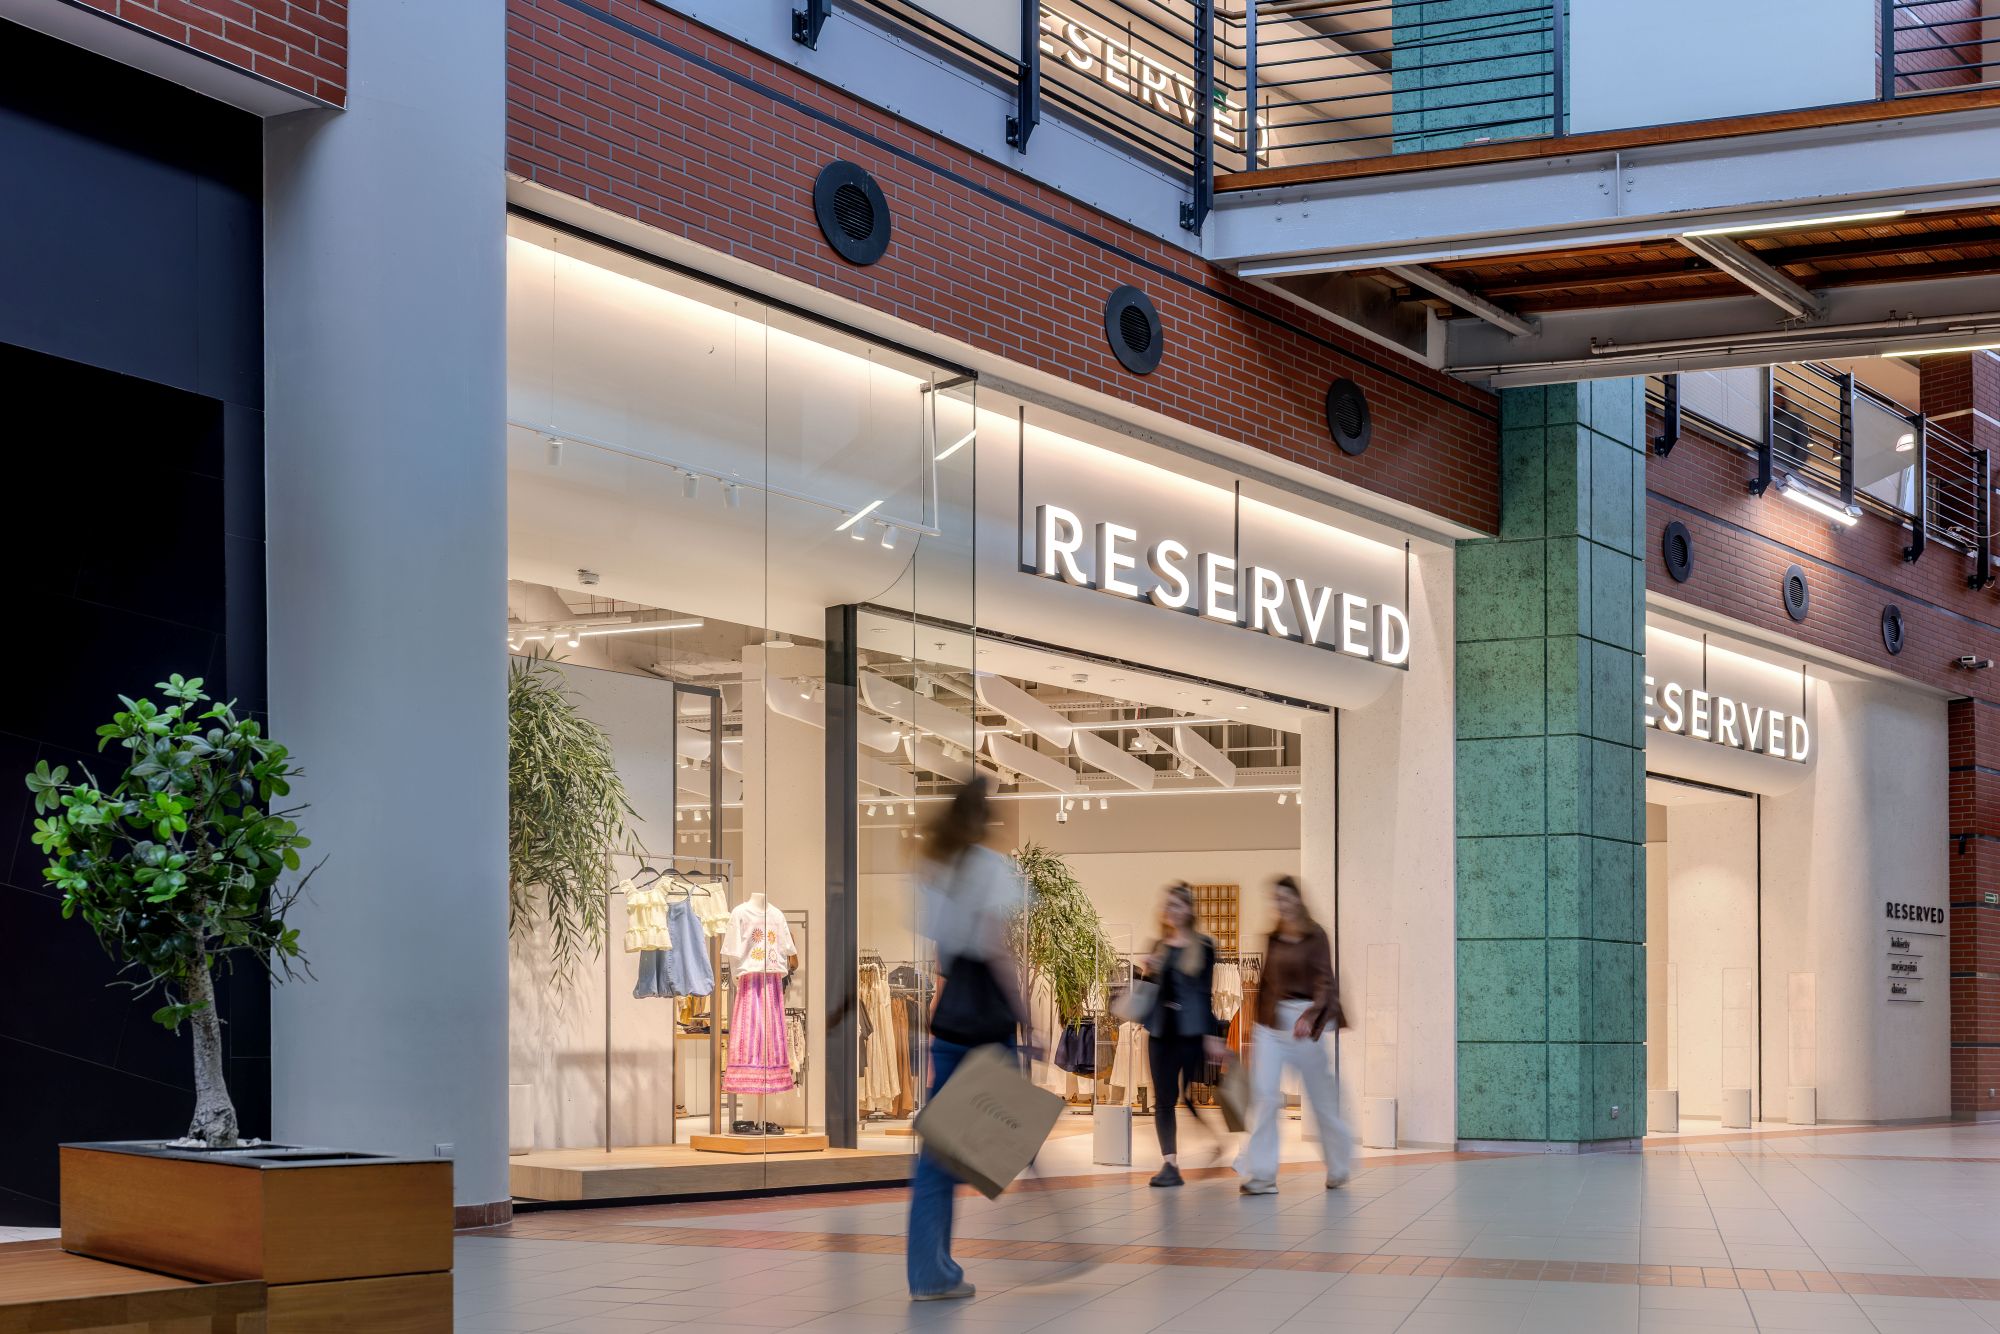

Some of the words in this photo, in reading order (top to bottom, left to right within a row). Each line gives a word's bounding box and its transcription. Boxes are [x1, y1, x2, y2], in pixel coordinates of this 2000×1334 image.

[1039, 6, 1268, 156] ESERVED
[1037, 504, 1410, 664] RESERVED
[1645, 675, 1810, 761] ESERVED
[1886, 902, 1944, 923] RESERVED
